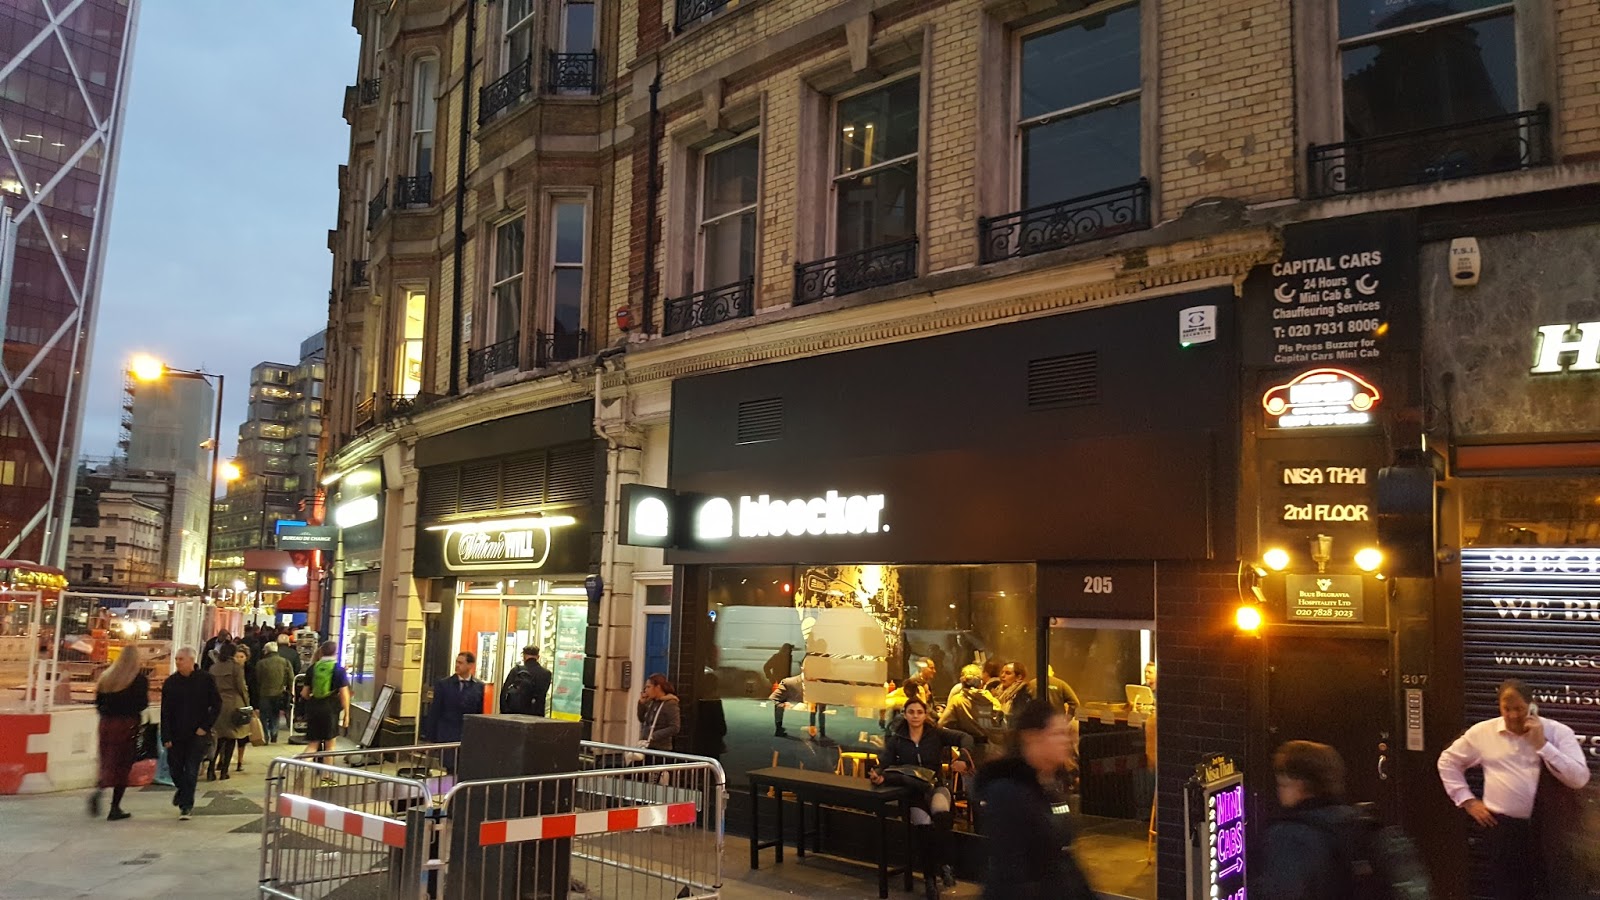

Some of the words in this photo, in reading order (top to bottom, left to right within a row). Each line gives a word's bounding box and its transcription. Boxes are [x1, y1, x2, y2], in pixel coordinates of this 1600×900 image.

[1272, 257, 1336, 276] CAPITAL
[1339, 251, 1381, 269] CARS
[1303, 278, 1316, 289] 24
[1318, 277, 1348, 288] Hours
[1299, 291, 1320, 304] Mini
[1321, 289, 1342, 301] Cab
[1343, 287, 1353, 299] &
[1273, 305, 1335, 319] Chauffeuring
[1336, 301, 1380, 314] Services
[1273, 326, 1286, 338] T:
[1288, 324, 1311, 337] 020
[1314, 321, 1344, 335] 7931
[1347, 318, 1379, 333] 8006
[1278, 344, 1294, 353] Pls
[1295, 343, 1323, 352] Press
[1325, 340, 1359, 350] Buzzer
[1360, 338, 1375, 347] for
[1274, 353, 1309, 364] Capital
[1311, 352, 1334, 361] Cars
[1336, 350, 1357, 359] Mini
[1359, 348, 1380, 358] Cab
[1283, 467, 1324, 484] NISA
[1325, 466, 1367, 484] THAI
[1283, 503, 1312, 520] 2nd
[1314, 504, 1369, 521] FLOOR
[504, 530, 534, 559] HILL
[1083, 576, 1113, 594] 205
[1313, 608, 1333, 618] 7828
[1333, 610, 1354, 618] 3023
[1489, 598, 1552, 620] WE
[1402, 674, 1428, 685] 207
[1216, 786, 1242, 826] MINI
[1217, 821, 1243, 863] CABS
